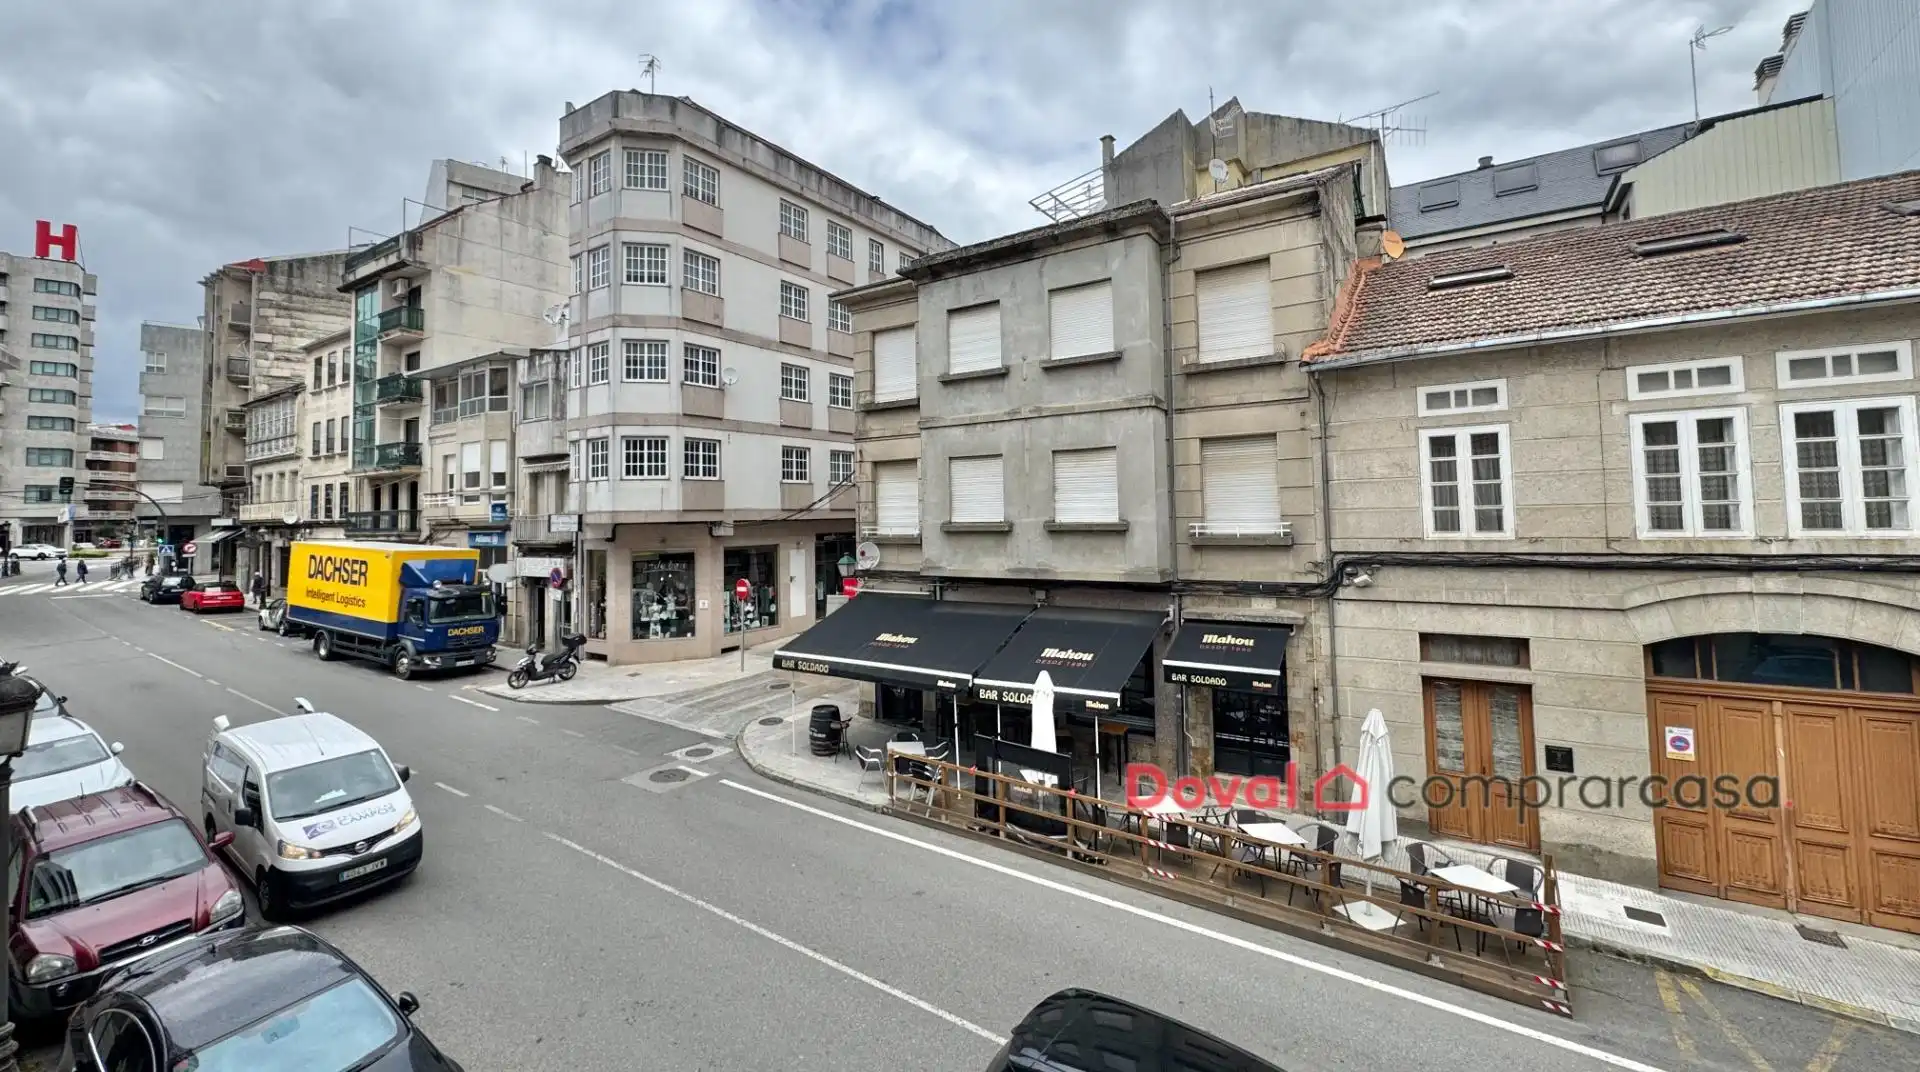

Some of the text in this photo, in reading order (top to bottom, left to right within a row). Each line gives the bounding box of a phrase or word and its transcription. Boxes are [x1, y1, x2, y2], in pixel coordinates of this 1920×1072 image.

[35, 219, 77, 261] H
[308, 554, 368, 587] DACHSER
[306, 587, 366, 608] Intelligent Logistics
[448, 625, 484, 637] DACHSER
[1203, 634, 1255, 646] Mahou
[1040, 648, 1094, 661] Mahou
[781, 659, 829, 674] BAR SOLDADO
[1171, 673, 1227, 686] BAR SOLDADO
[979, 688, 1034, 704] BAR SOLDA
